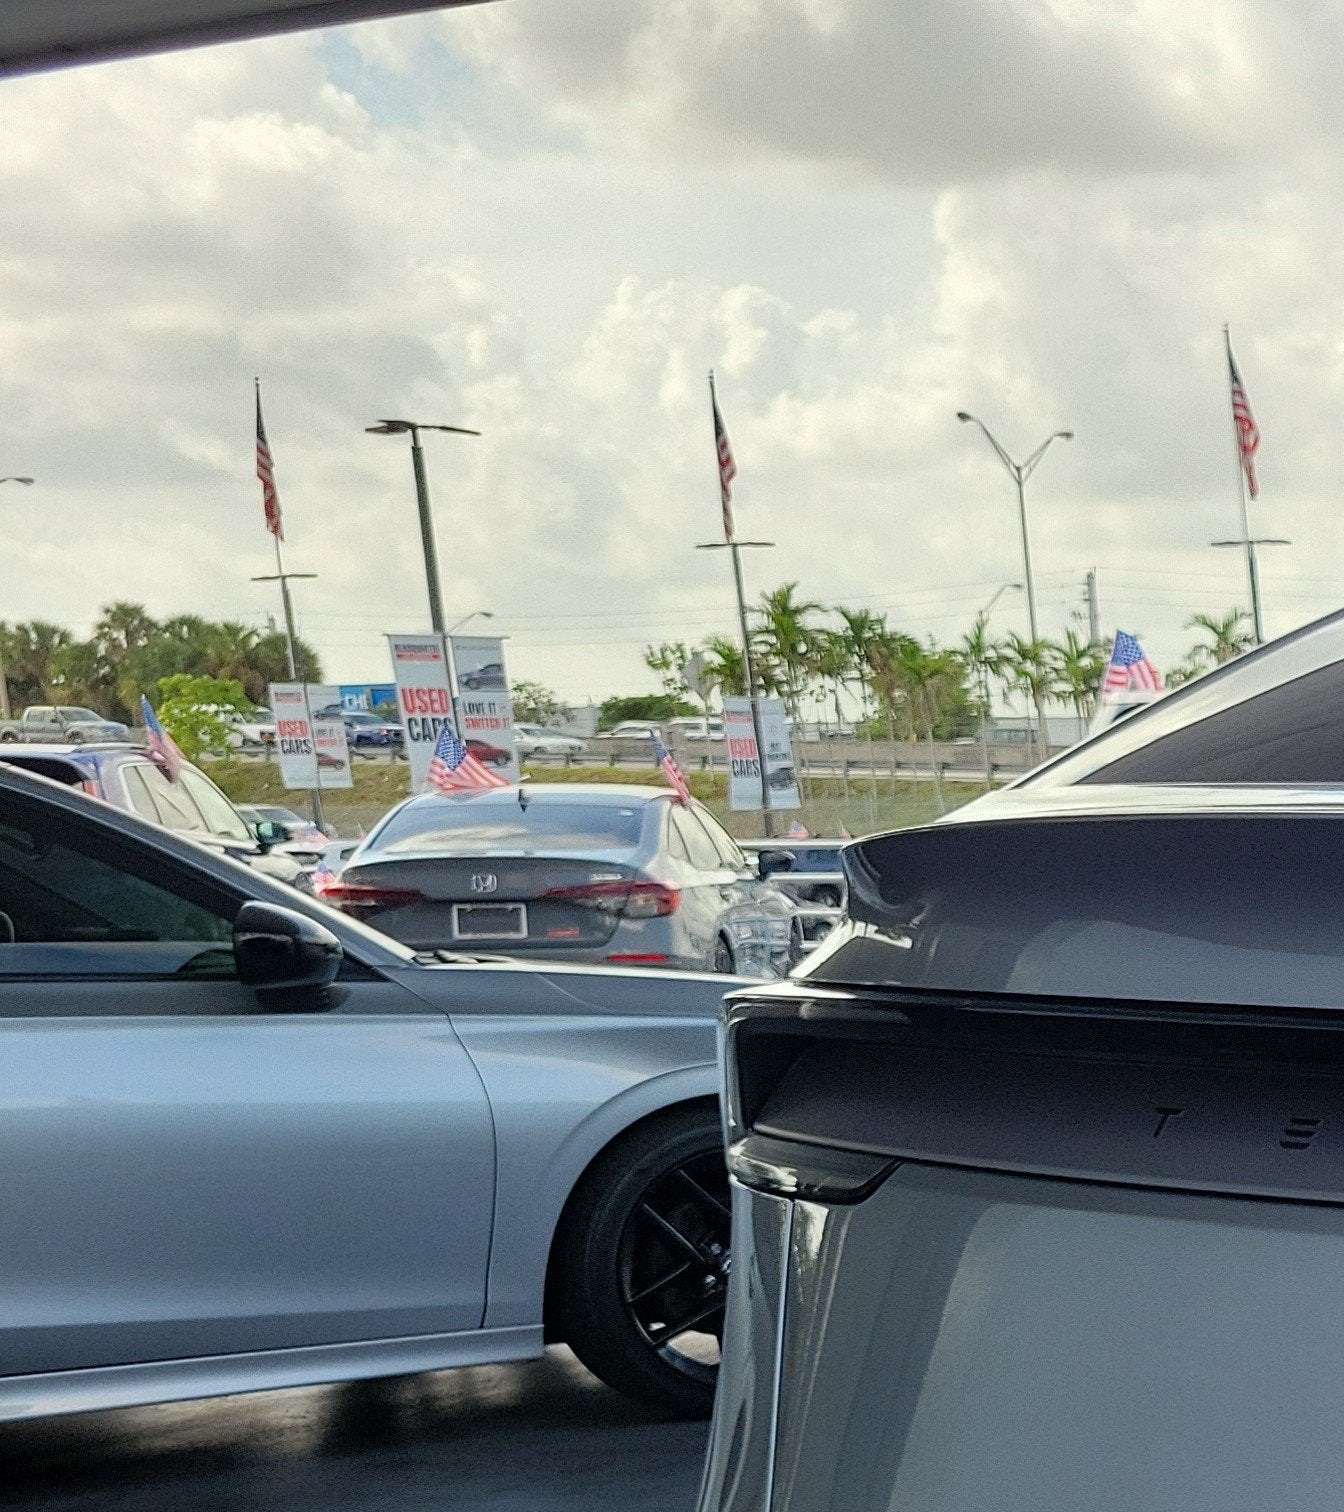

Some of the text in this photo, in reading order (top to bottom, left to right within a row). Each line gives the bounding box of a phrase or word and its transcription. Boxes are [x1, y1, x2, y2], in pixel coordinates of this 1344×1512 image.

[402, 688, 449, 714] USED
[488, 702, 497, 715] IT
[278, 721, 309, 737] USED
[465, 718, 500, 729] SWITCH
[281, 739, 312, 755] CARS
[730, 739, 757, 757] USED
[732, 759, 760, 777] CARS
